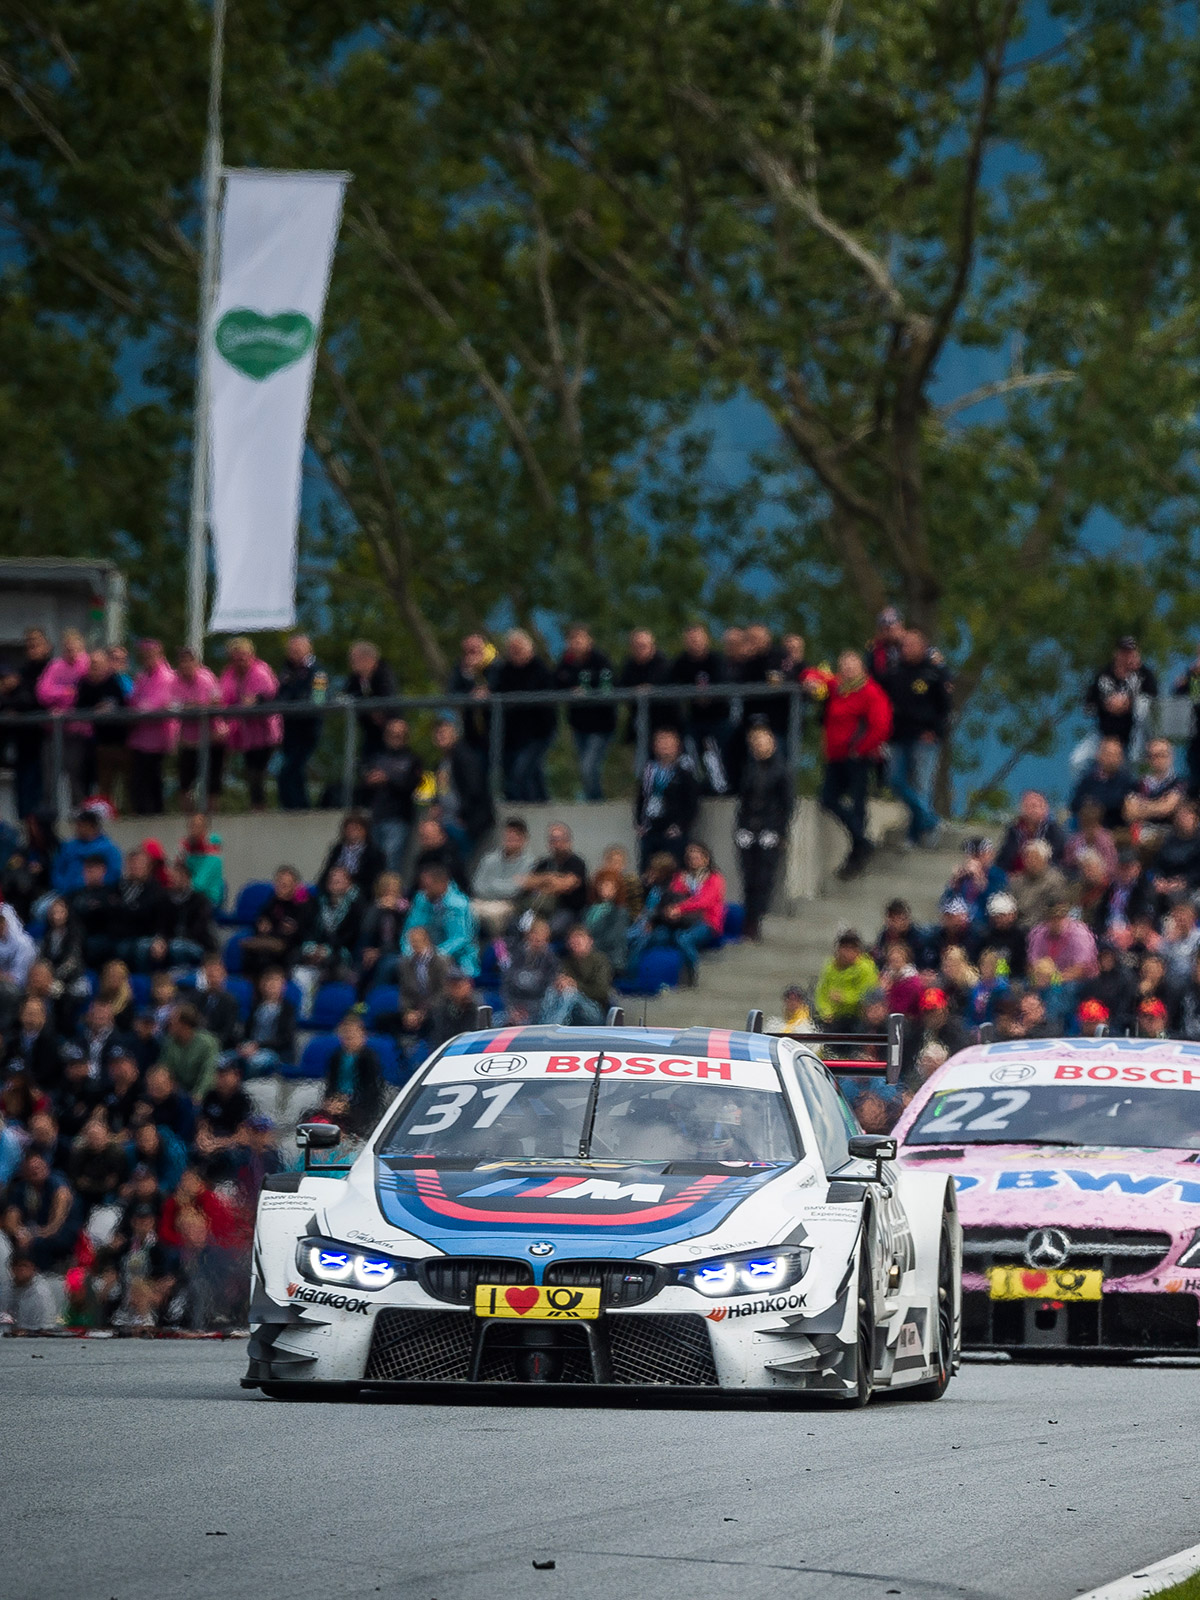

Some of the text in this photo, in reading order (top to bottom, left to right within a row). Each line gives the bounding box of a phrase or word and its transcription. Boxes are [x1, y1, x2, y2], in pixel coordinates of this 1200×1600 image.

[545, 1055, 732, 1081] BOSCH
[407, 1082, 524, 1136] 31
[919, 1089, 1032, 1135] 22
